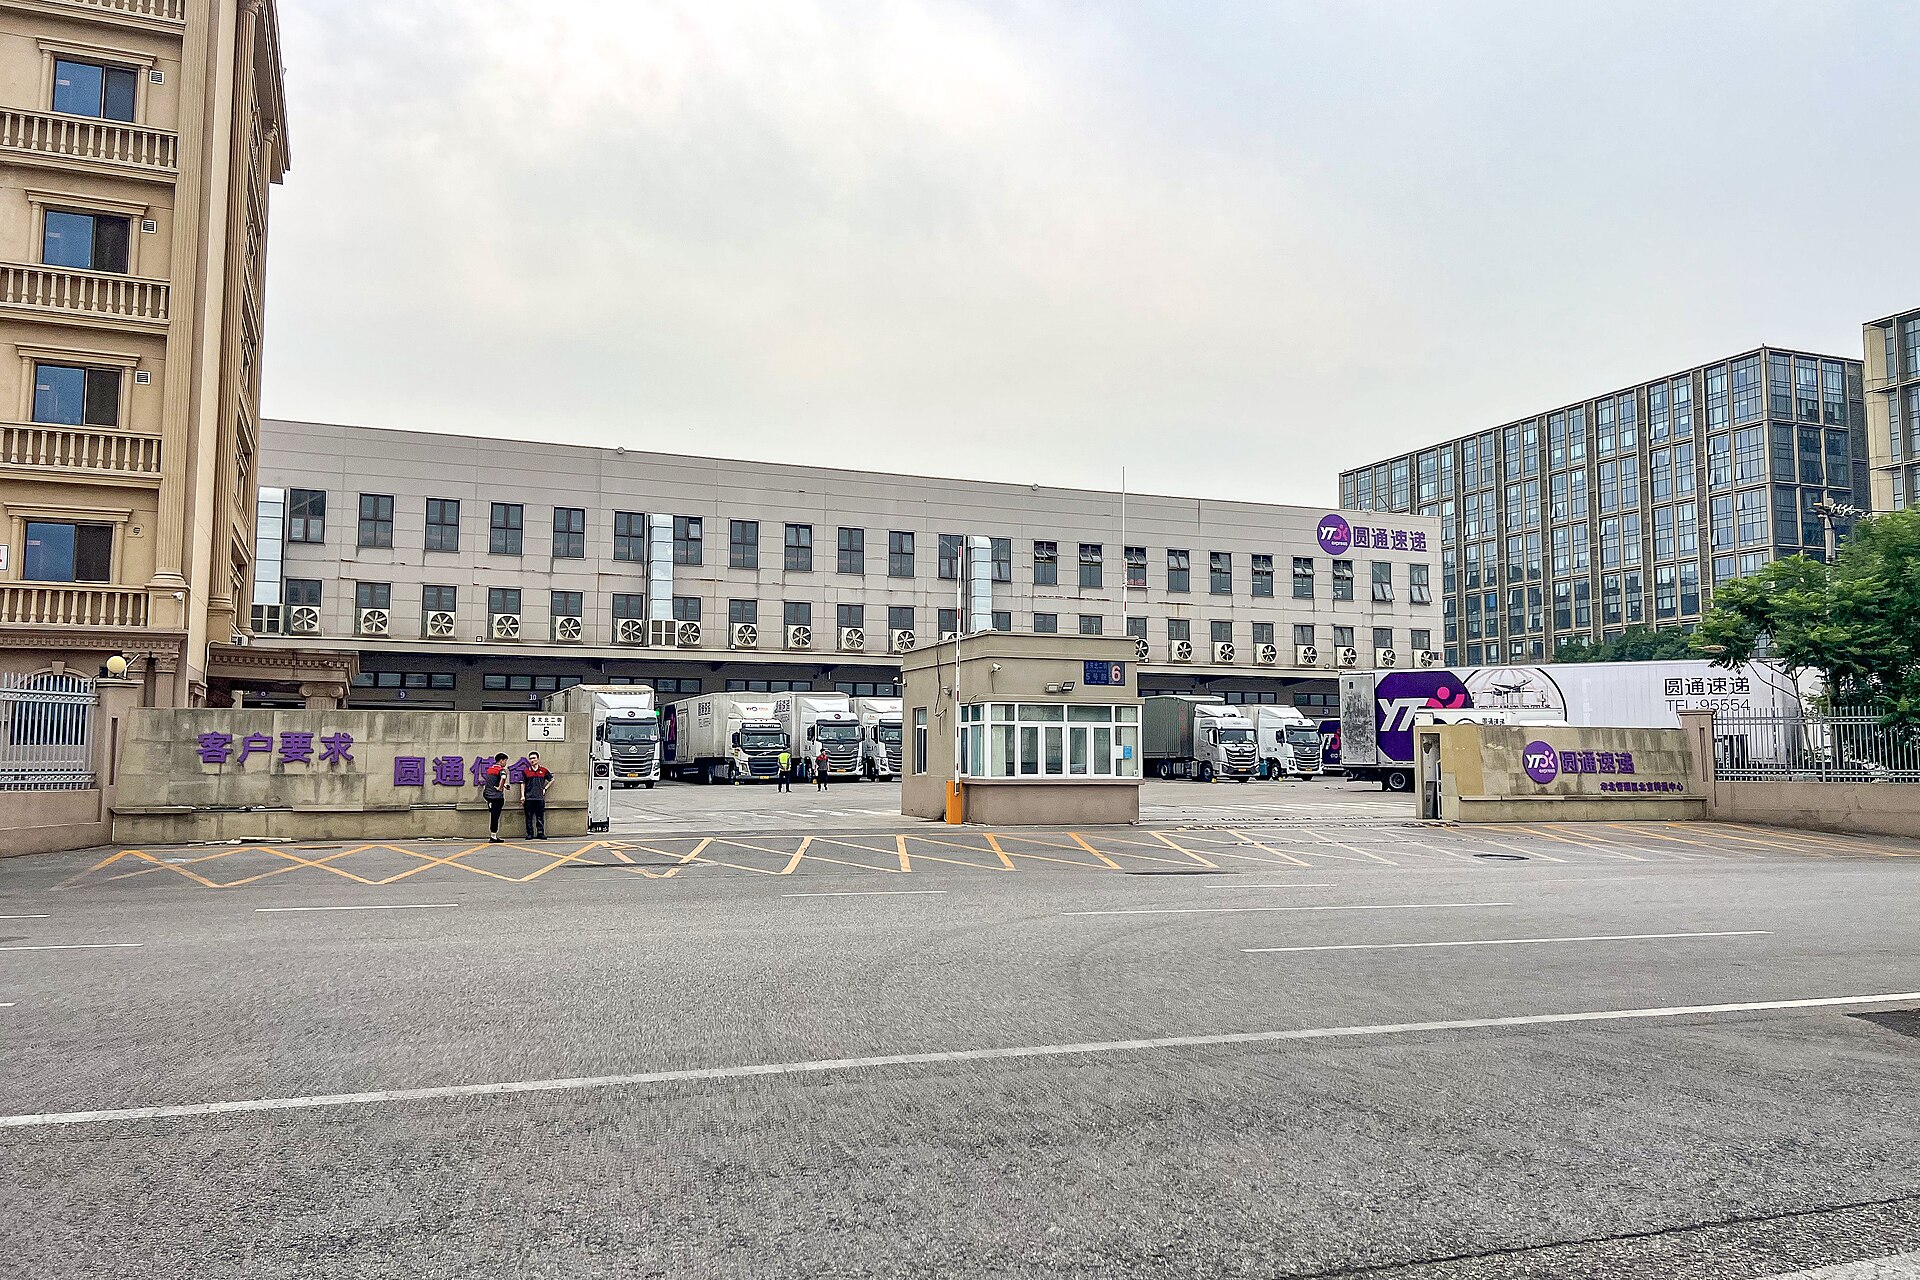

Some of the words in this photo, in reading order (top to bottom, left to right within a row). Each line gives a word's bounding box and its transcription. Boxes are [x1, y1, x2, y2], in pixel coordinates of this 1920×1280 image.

[1353, 526, 1428, 552] 圆通速递
[1111, 665, 1121, 682] 6
[1664, 677, 1751, 696] 圆通速递
[543, 726, 550, 737] 5
[196, 731, 354, 764] 客户要求
[1559, 751, 1636, 775] 圆通速递
